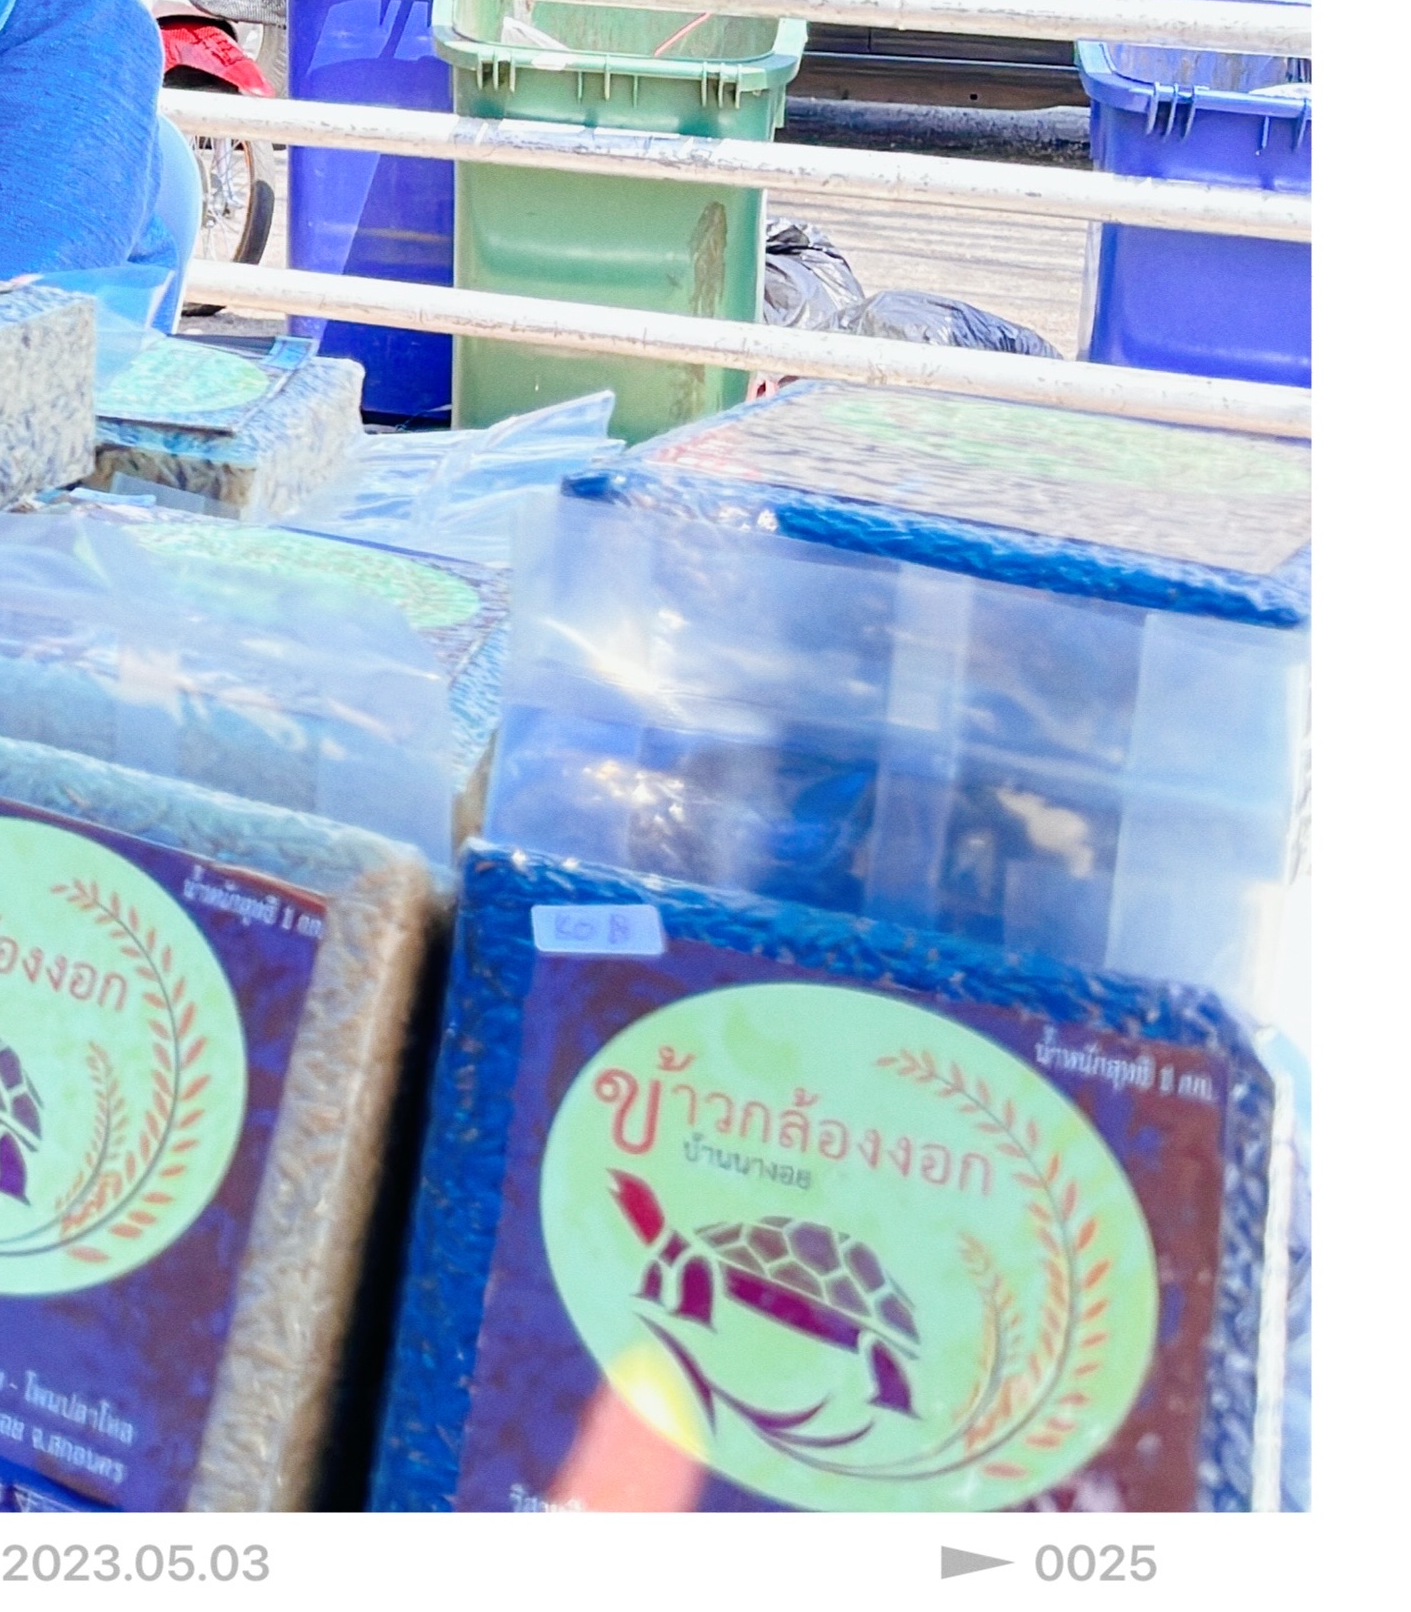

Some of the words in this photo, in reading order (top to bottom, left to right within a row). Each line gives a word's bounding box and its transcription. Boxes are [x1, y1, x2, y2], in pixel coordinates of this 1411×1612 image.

[593, 1045, 996, 1198] ข้าวกล้องงอก
